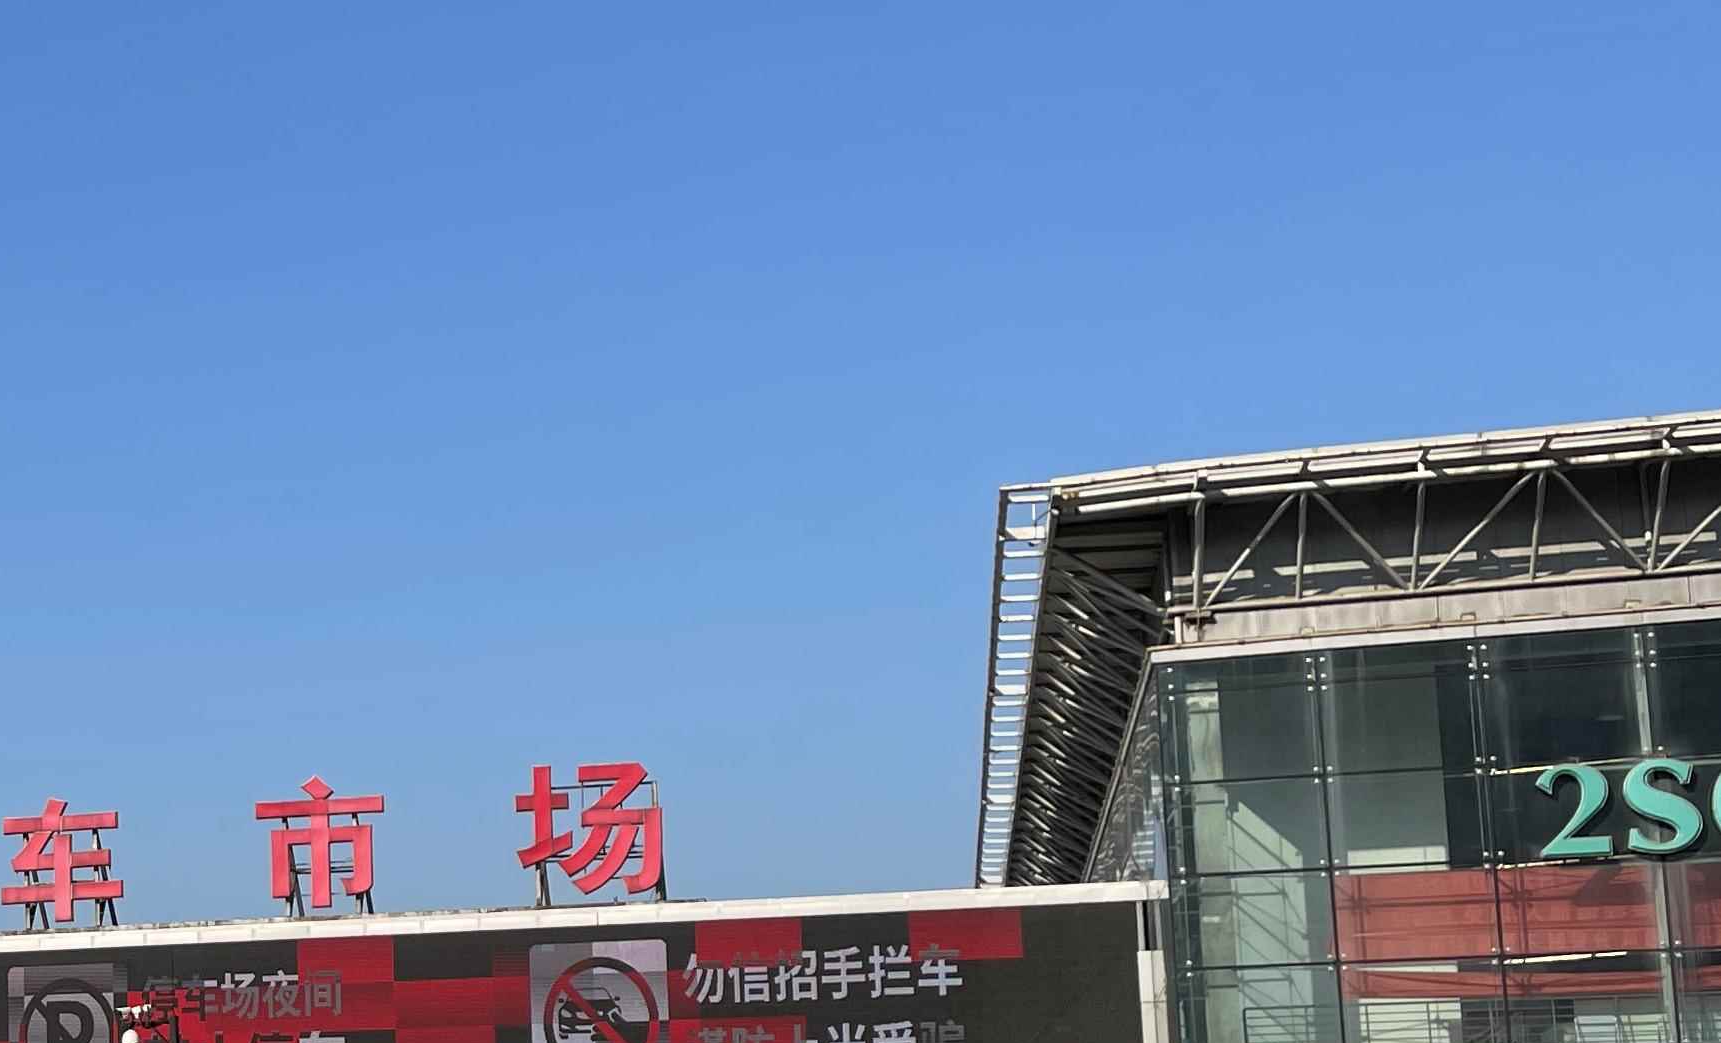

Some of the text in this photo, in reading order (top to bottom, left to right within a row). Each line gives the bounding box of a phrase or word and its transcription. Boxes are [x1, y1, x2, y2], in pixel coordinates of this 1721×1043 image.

[1536, 757, 1721, 857] 2S
[142, 968, 342, 1022] 停车场夜间
[683, 943, 963, 1004] 勿信招手拦车
